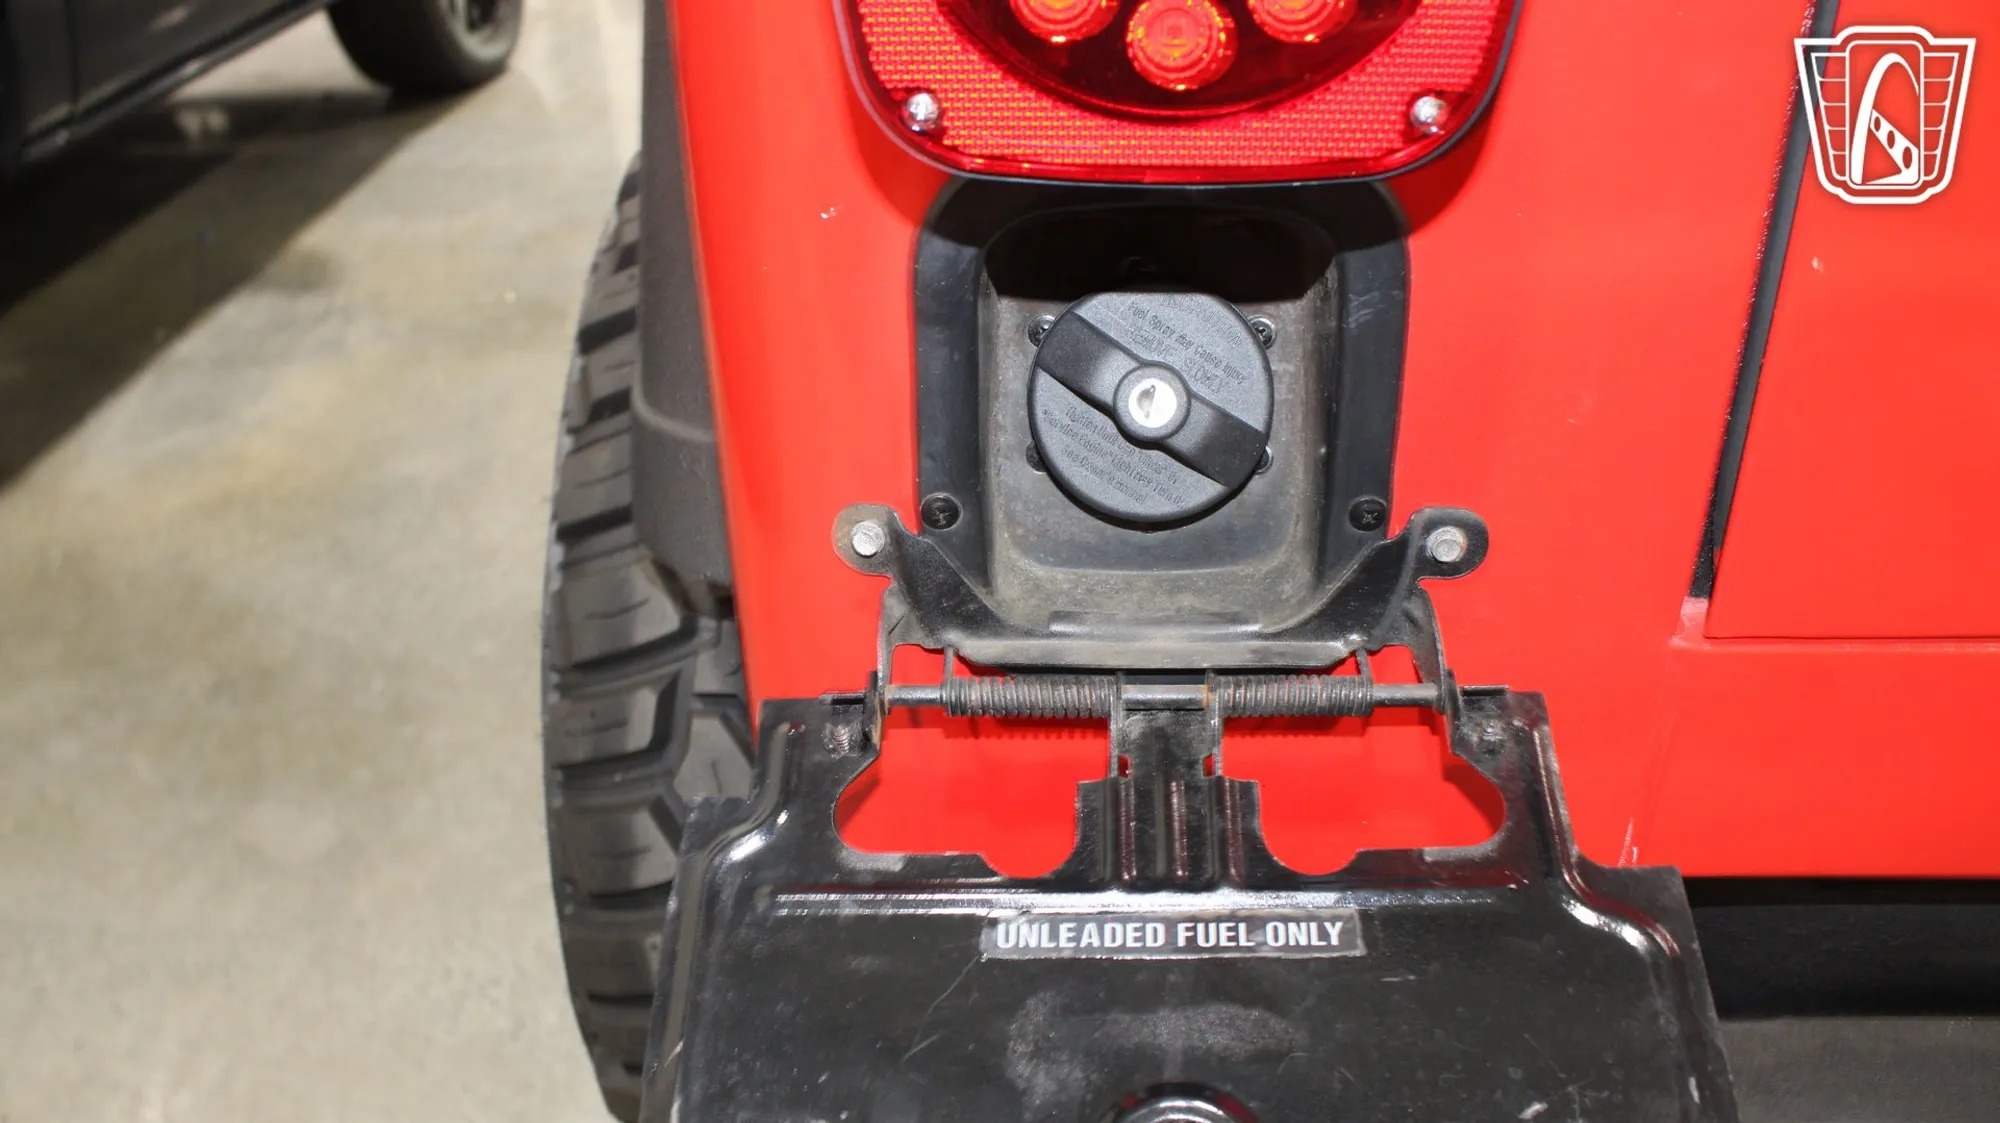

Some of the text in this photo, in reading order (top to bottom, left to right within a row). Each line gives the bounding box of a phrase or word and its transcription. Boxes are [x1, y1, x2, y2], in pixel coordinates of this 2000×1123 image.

[1127, 301, 1150, 319] Fuel
[1148, 314, 1176, 338] Spray
[1194, 344, 1222, 368] Cause
[1221, 361, 1247, 385] Injury
[996, 921, 1343, 948] UNLEADED FUEL ONLY
